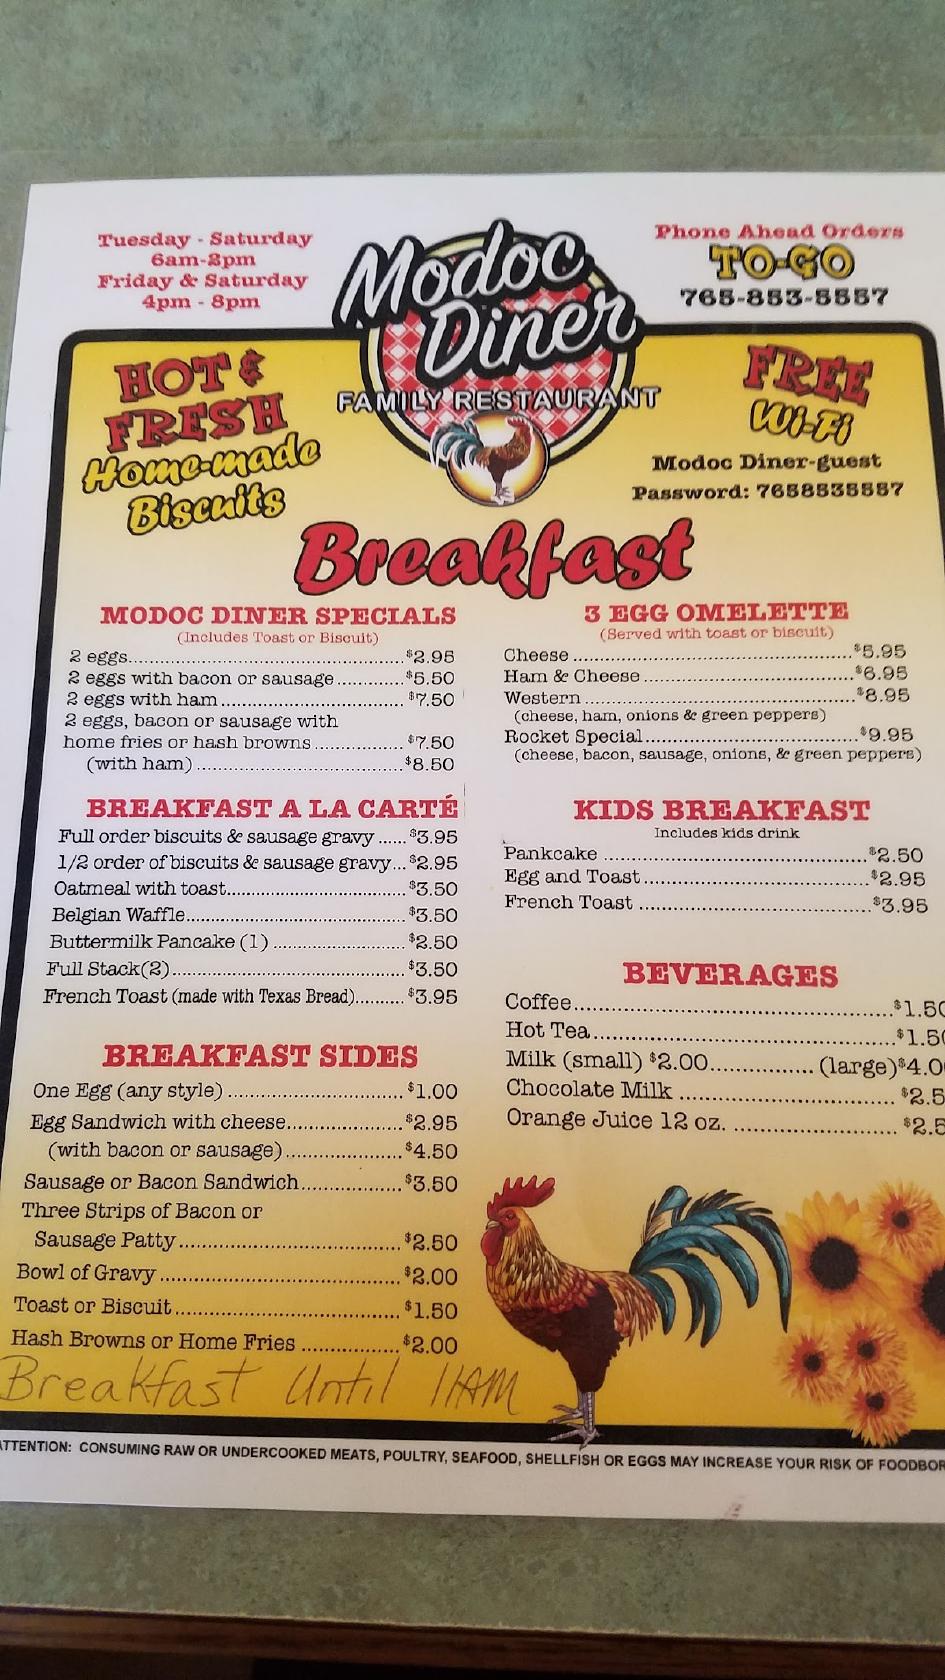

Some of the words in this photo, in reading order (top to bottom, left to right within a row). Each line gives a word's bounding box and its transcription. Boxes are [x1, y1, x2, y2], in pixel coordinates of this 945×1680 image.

[655, 225, 730, 239] Phone
[738, 225, 814, 239] Ahead
[822, 224, 903, 238] Orders
[151, 253, 255, 269] 6am-2pm
[711, 244, 854, 280] TO-GO
[98, 273, 173, 291] Friday
[180, 274, 198, 287] &
[205, 273, 308, 290] Saturday
[336, 220, 588, 324] Modoc
[681, 288, 888, 306] 765-853-5557
[419, 288, 642, 384] Diner
[113, 353, 231, 403] HOT
[238, 349, 266, 387] &
[743, 344, 873, 407] FREE
[337, 390, 443, 413] FAMILY
[455, 387, 661, 412] RESTAURANT
[104, 393, 287, 453] FRESH
[750, 400, 854, 446] Wi-Fi
[83, 432, 320, 494] Home-made
[652, 455, 732, 471] Modoc
[740, 453, 882, 472] Diner-guest
[632, 484, 749, 500] Password:
[128, 484, 285, 535] Biscuits
[294, 518, 695, 600] Breakfast
[100, 607, 203, 624] MODOC
[211, 607, 308, 624] DINER
[316, 607, 456, 625] SPECIALS
[585, 606, 600, 623] 3
[609, 604, 669, 622] EGG
[677, 602, 848, 622] OMELETTE
[178, 632, 248, 644] (Includes
[253, 632, 294, 643] Toast
[299, 635, 315, 643] or
[321, 632, 378, 646] Biscuit)
[70, 650, 80, 662] 2
[88, 651, 127, 666] eggs
[407, 649, 454, 663] $2.95
[505, 649, 568, 661] Cheese
[855, 644, 906, 658] $5.95
[68, 671, 79, 684] 2
[86, 673, 125, 687] eggs
[131, 672, 173, 684] with
[178, 672, 231, 685] bacon
[238, 675, 257, 685] or
[262, 674, 333, 687] sausage
[406, 670, 454, 685] $5.50
[504, 691, 580, 704] Western
[857, 687, 909, 702] $8.95
[505, 730, 569, 743] Rocket
[576, 729, 642, 746] Special
[861, 726, 913, 742] $9.95
[515, 749, 578, 763] (cheese,
[583, 749, 634, 762] bacon,
[640, 750, 706, 762] sausage,
[713, 748, 770, 762] onions,
[777, 748, 790, 759] &
[795, 749, 842, 762] green
[847, 747, 921, 762] peppers)
[87, 799, 272, 818] BREAKFAST
[279, 800, 301, 818] A
[309, 800, 351, 818] LA
[358, 794, 458, 818] CARTÉ
[574, 800, 653, 820] KIDS
[663, 800, 870, 821] BREAKFAST
[655, 828, 717, 838] Includes
[721, 828, 753, 838] kids
[758, 828, 800, 838] drink
[504, 847, 597, 860] Pankcake
[870, 847, 923, 863] $2.50
[55, 881, 130, 895] Oatmeal
[135, 881, 176, 895] with
[181, 882, 226, 895] toast
[409, 880, 457, 896] $3.50
[505, 895, 573, 909] French
[579, 895, 632, 909] Toast
[873, 896, 928, 913] $3.95
[52, 908, 121, 925] Belgian
[126, 907, 184, 922] Waffle
[409, 906, 457, 922] $3.50
[50, 934, 153, 948] Buttermilk
[157, 934, 235, 948] Pancake
[240, 934, 268, 952] (1)
[409, 933, 457, 949] $2.50
[623, 962, 838, 988] BEVERAGES
[43, 989, 111, 1004] French
[116, 989, 168, 1003] Toast
[172, 988, 217, 1005] (made
[222, 989, 254, 1003] with
[259, 989, 300, 1003] Texas
[306, 989, 354, 1006] Bread)
[408, 987, 457, 1004] $3.95
[506, 993, 571, 1010] Coffee
[102, 1044, 311, 1067] BREAKFAST
[320, 1044, 417, 1068] SIDES
[506, 1050, 556, 1067] Milk
[564, 1051, 642, 1074] (small)
[650, 1052, 707, 1070] $2.00
[899, 1057, 945, 1076] $4.0
[34, 1083, 69, 1098] One
[75, 1083, 112, 1101] Egg
[118, 1082, 162, 1101] (any
[168, 1082, 222, 1101] style)
[408, 1082, 457, 1099] $1.00
[507, 1078, 614, 1098] Chocolate
[621, 1081, 673, 1099] Milk
[30, 1114, 66, 1133] Egg
[72, 1114, 167, 1129] Sandwich
[172, 1114, 216, 1129] with
[221, 1114, 285, 1129] cheese
[406, 1114, 457, 1131] $2.95
[508, 1108, 585, 1130] Orange
[593, 1111, 652, 1129] Juice
[661, 1112, 688, 1130] 12
[695, 1117, 725, 1131] oz.
[24, 1173, 104, 1193] Sausage
[111, 1177, 132, 1189] or
[137, 1174, 198, 1189] Bacon
[204, 1174, 299, 1190] Sandwich
[405, 1174, 457, 1192] $3.50
[16, 1263, 64, 1279] Bowl
[71, 1264, 91, 1280] of
[95, 1264, 157, 1285] Gravy
[405, 1266, 457, 1285] $2.00
[0, 1355, 263, 1410] Breakfast
[285, 1358, 400, 1407] Until
[430, 1361, 520, 1416] 11AM
[0, 1440, 71, 1452] TTENTION:
[80, 1442, 160, 1455] CONSUMING
[165, 1445, 195, 1455] RAW
[199, 1446, 217, 1456] OR
[222, 1446, 326, 1459] UNDERCOOKED
[331, 1449, 379, 1463] MEATS,
[384, 1450, 447, 1464] POULTRY,
[452, 1451, 521, 1466] SEAFOOD,
[526, 1453, 599, 1465] SHELLFISH
[605, 1455, 623, 1466] OR
[628, 1456, 666, 1467] EGGS
[671, 1456, 698, 1467] MAY
[703, 1457, 772, 1468] INCREASE
[777, 1458, 815, 1469] YOUR
[820, 1459, 851, 1470] RISK
[856, 1459, 873, 1470] OF
